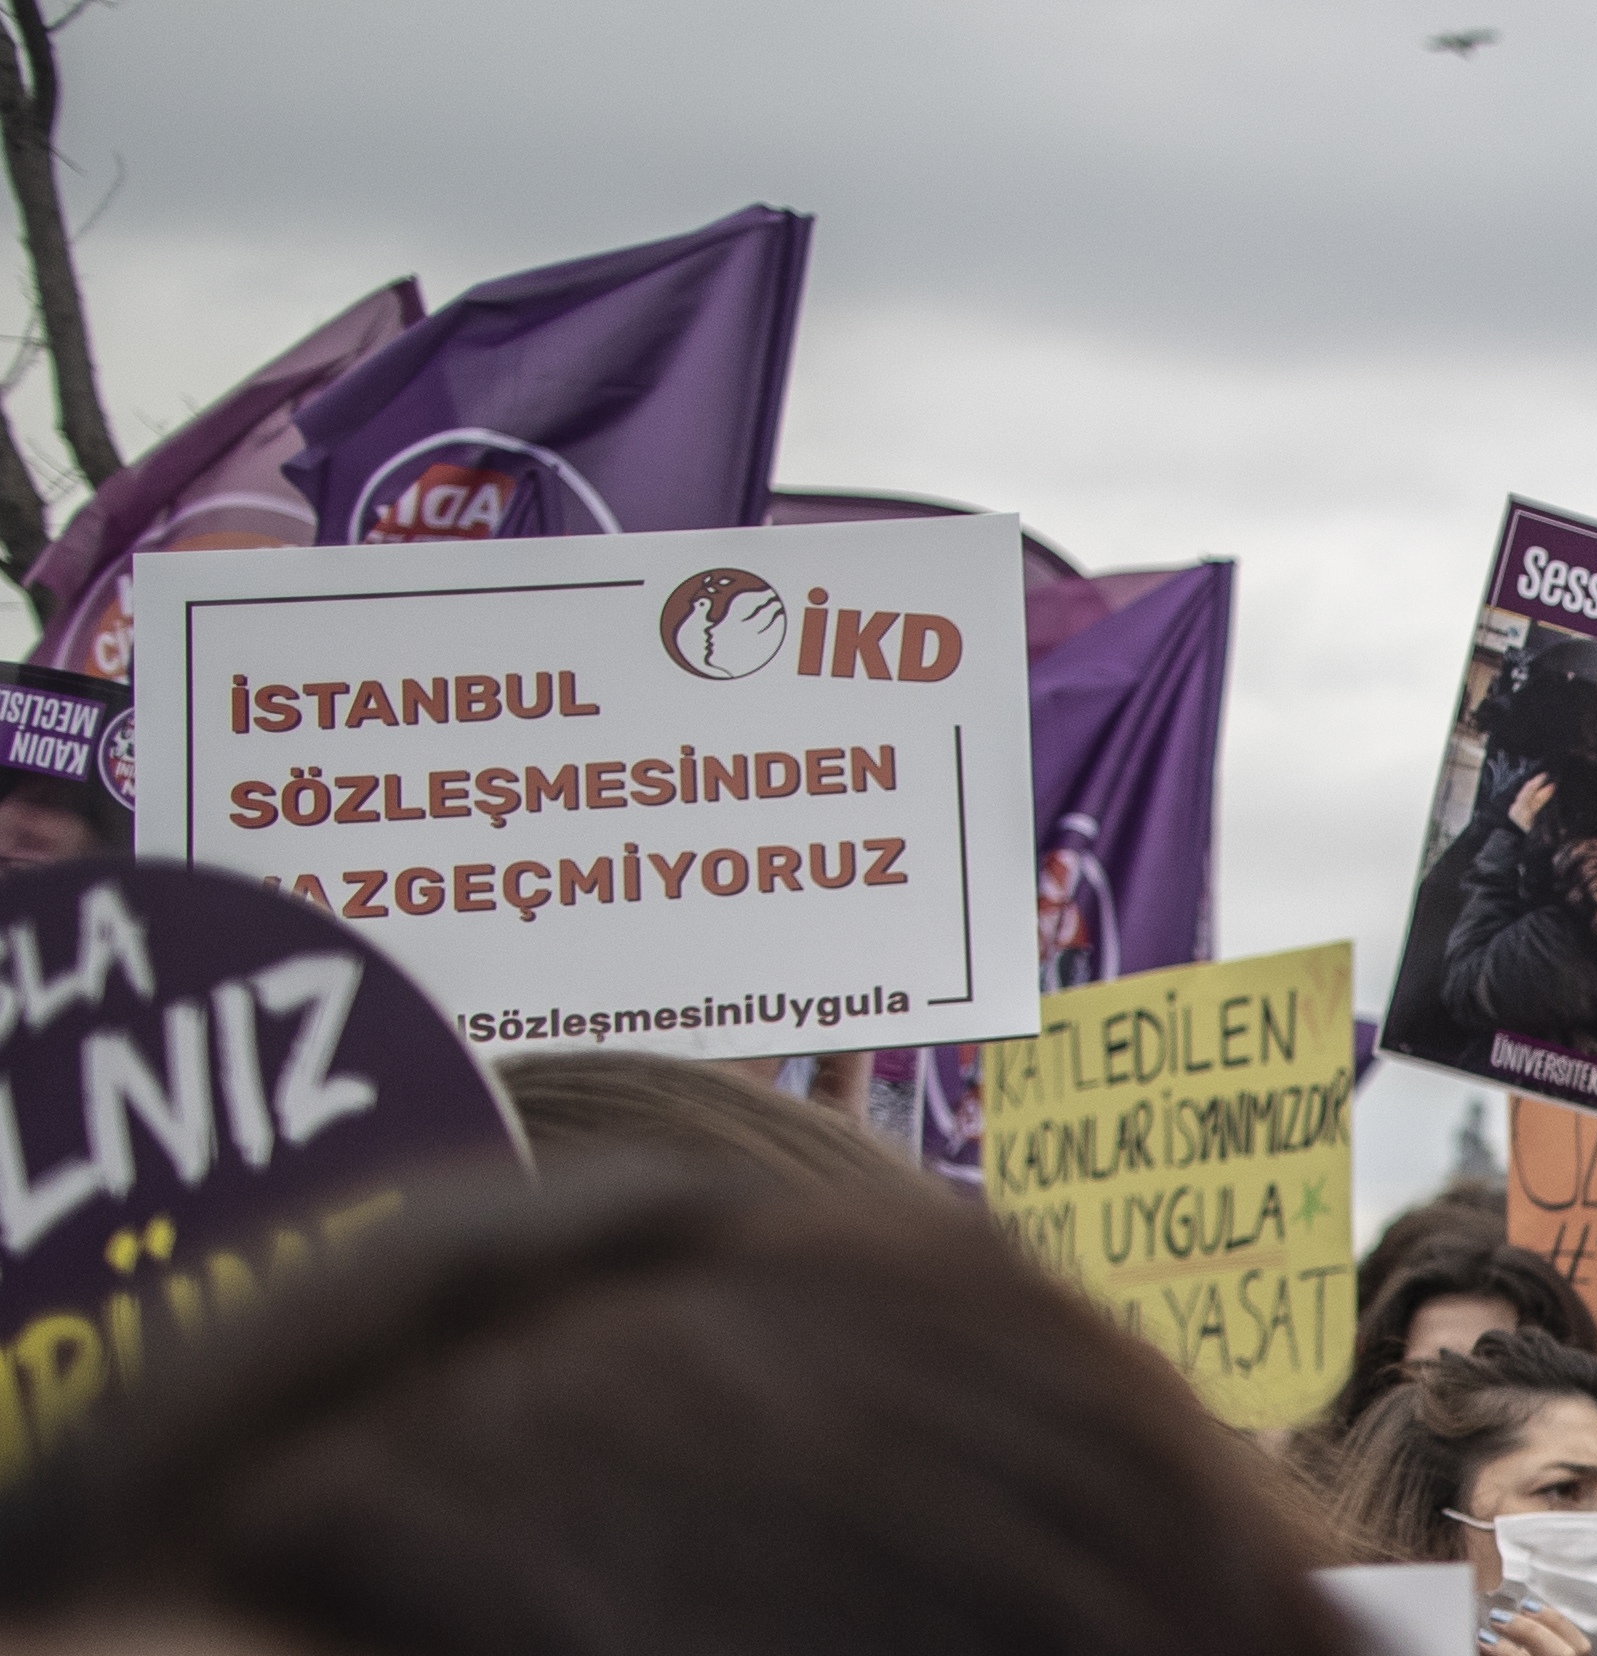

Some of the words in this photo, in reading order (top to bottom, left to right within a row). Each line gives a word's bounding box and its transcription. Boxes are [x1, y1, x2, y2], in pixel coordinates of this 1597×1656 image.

[797, 587, 963, 684] İKD
[229, 669, 600, 735] İSTANBUL
[9, 730, 90, 776] KADIN
[228, 743, 898, 832] SÖZLEŞMESİNDEN
[262, 837, 909, 923] AZGEÇMİYORUZ
[1102, 1181, 1287, 1265] UYGULA
